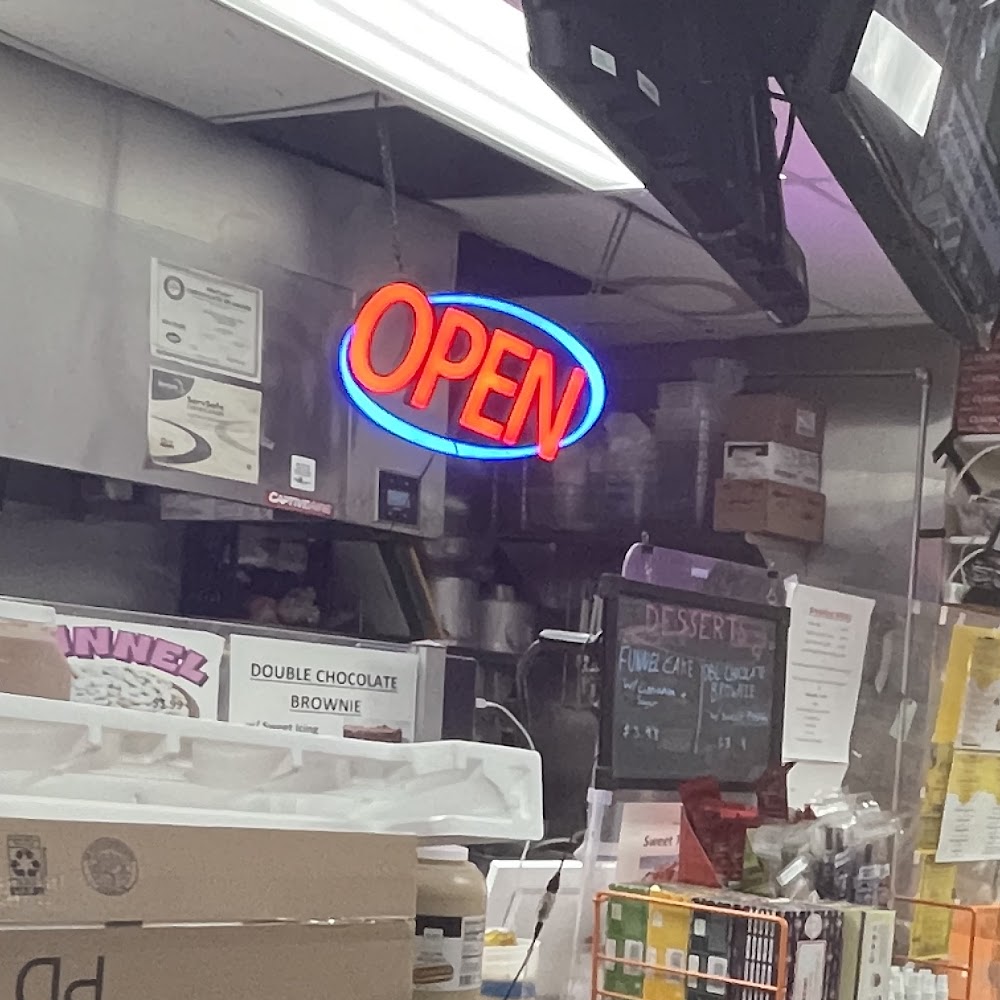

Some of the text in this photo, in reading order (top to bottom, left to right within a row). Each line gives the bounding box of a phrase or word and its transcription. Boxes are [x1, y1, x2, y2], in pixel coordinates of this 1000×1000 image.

[349, 281, 588, 462] OPEN
[645, 603, 748, 643] DESSERTS
[250, 662, 399, 691] DOUBLE CHOCOLATE
[290, 694, 362, 714] BROWNIE
[643, 835, 673, 847] Sweet
